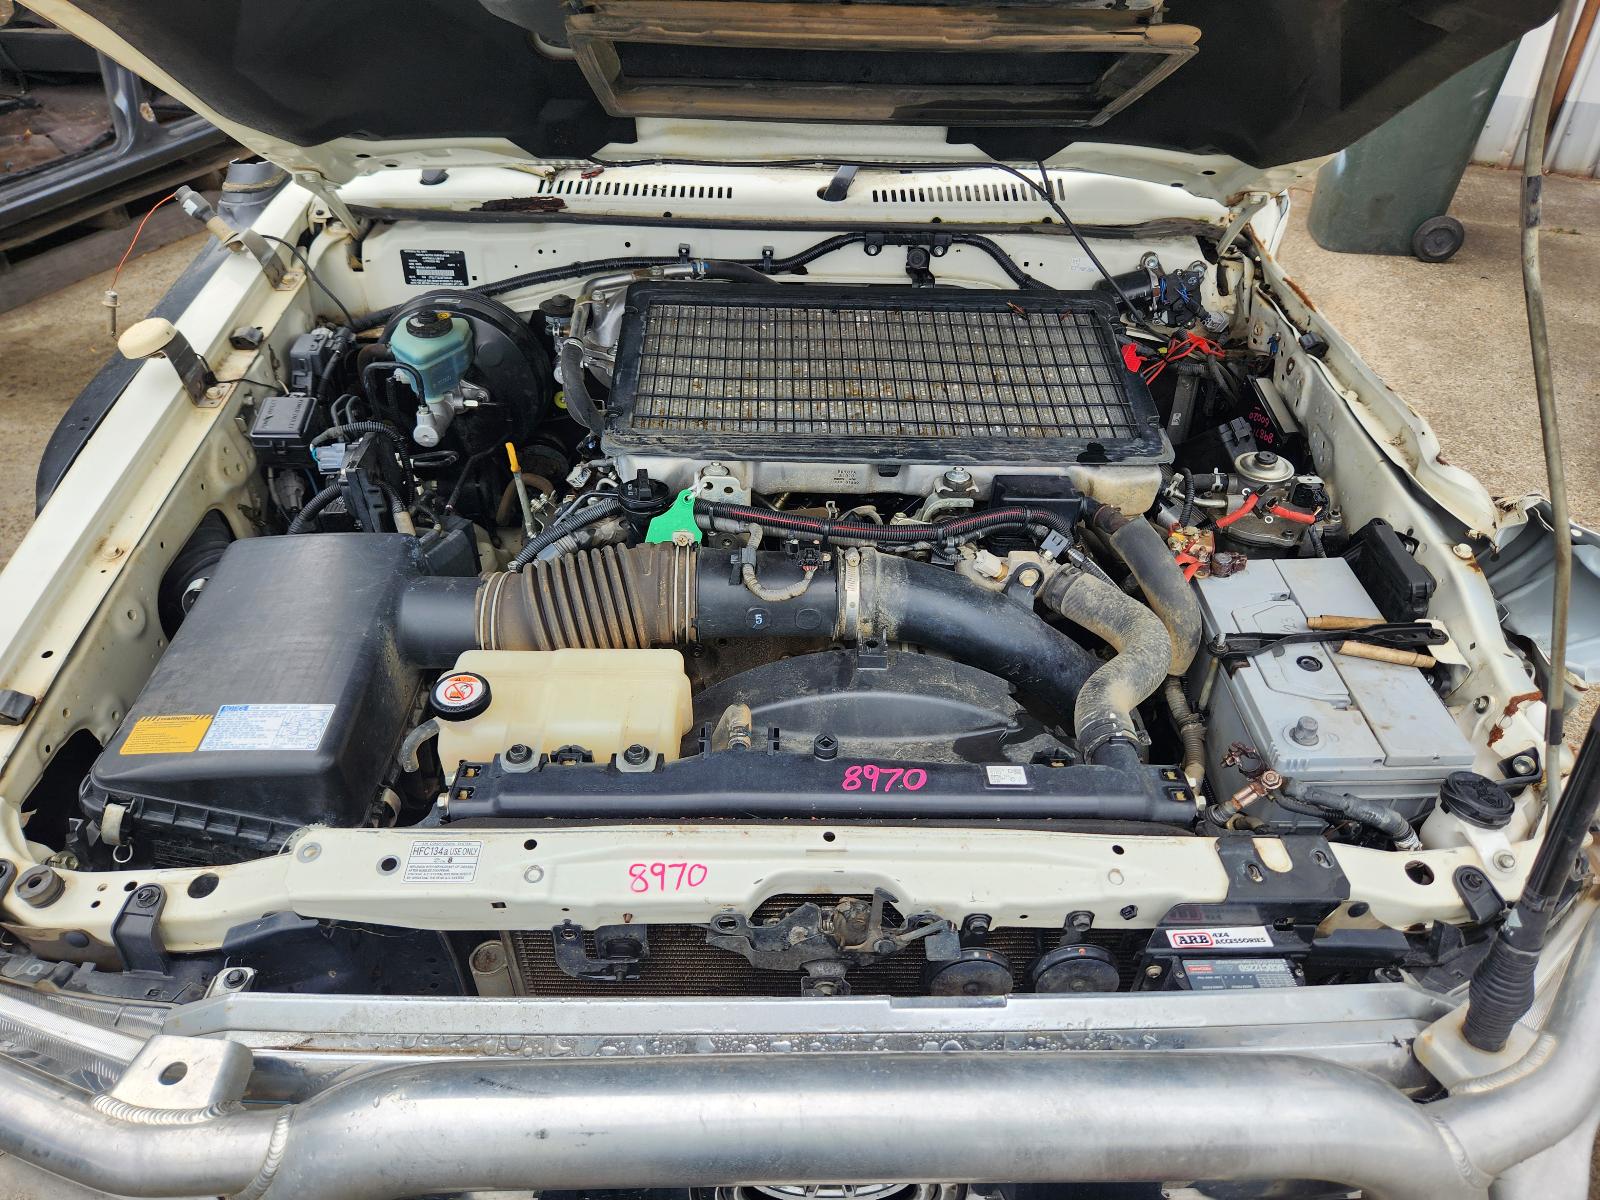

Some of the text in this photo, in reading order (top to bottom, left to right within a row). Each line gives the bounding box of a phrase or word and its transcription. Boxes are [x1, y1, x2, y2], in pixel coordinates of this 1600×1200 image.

[754, 613, 763, 625] 5
[841, 764, 928, 792] 8970
[449, 847, 463, 856] USE
[462, 847, 479, 856] ONLY
[629, 862, 708, 893] 8970
[1178, 935, 1211, 945] ARB
[1215, 937, 1267, 945] ACCESSORIES
